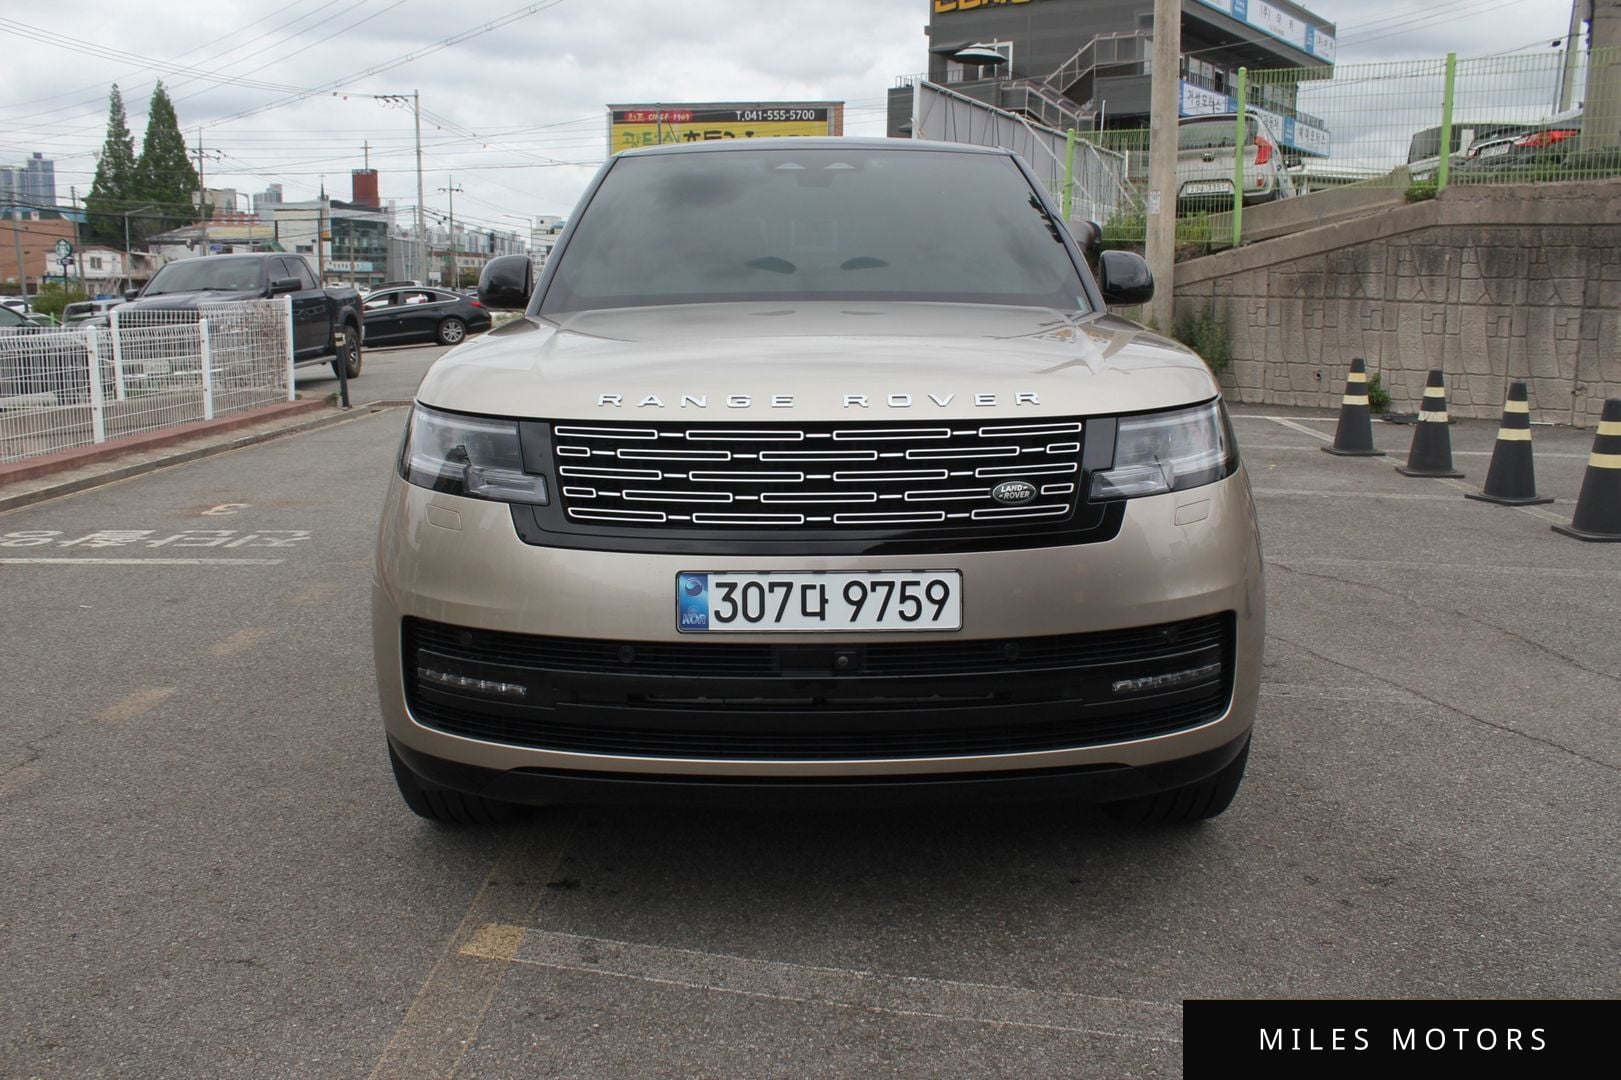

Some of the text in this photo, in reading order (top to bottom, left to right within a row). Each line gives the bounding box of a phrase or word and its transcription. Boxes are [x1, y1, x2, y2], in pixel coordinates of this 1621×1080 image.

[736, 110, 815, 122] T.041-555-5700
[598, 391, 1041, 408] RANGE ROVER
[1000, 484, 1023, 493] LAND
[1003, 490, 1030, 500] ROVER
[713, 579, 950, 623] 307다 9759
